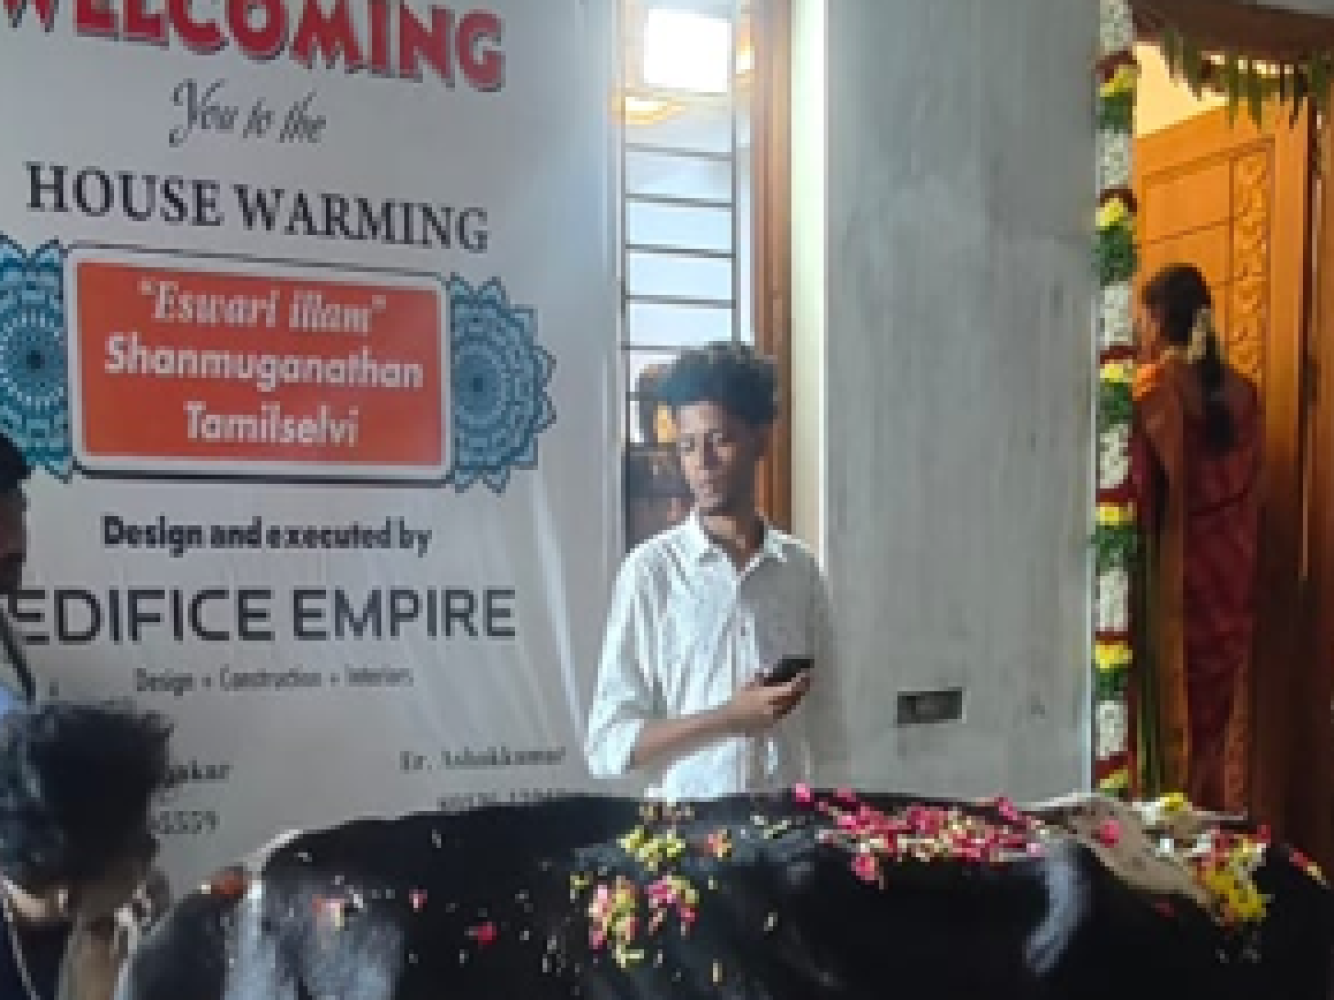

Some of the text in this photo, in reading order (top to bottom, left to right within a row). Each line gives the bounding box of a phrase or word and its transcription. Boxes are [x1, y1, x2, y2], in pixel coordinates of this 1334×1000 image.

[169, 78, 327, 146] You to the
[25, 161, 490, 253] HOUSE WARMING
[105, 332, 424, 393] Shanmuganathan
[183, 400, 359, 447] Tamilselvi
[102, 514, 433, 559] Design and executed by
[10, 587, 517, 646] EDIFICE EMPIRE
[134, 666, 195, 697] Design
